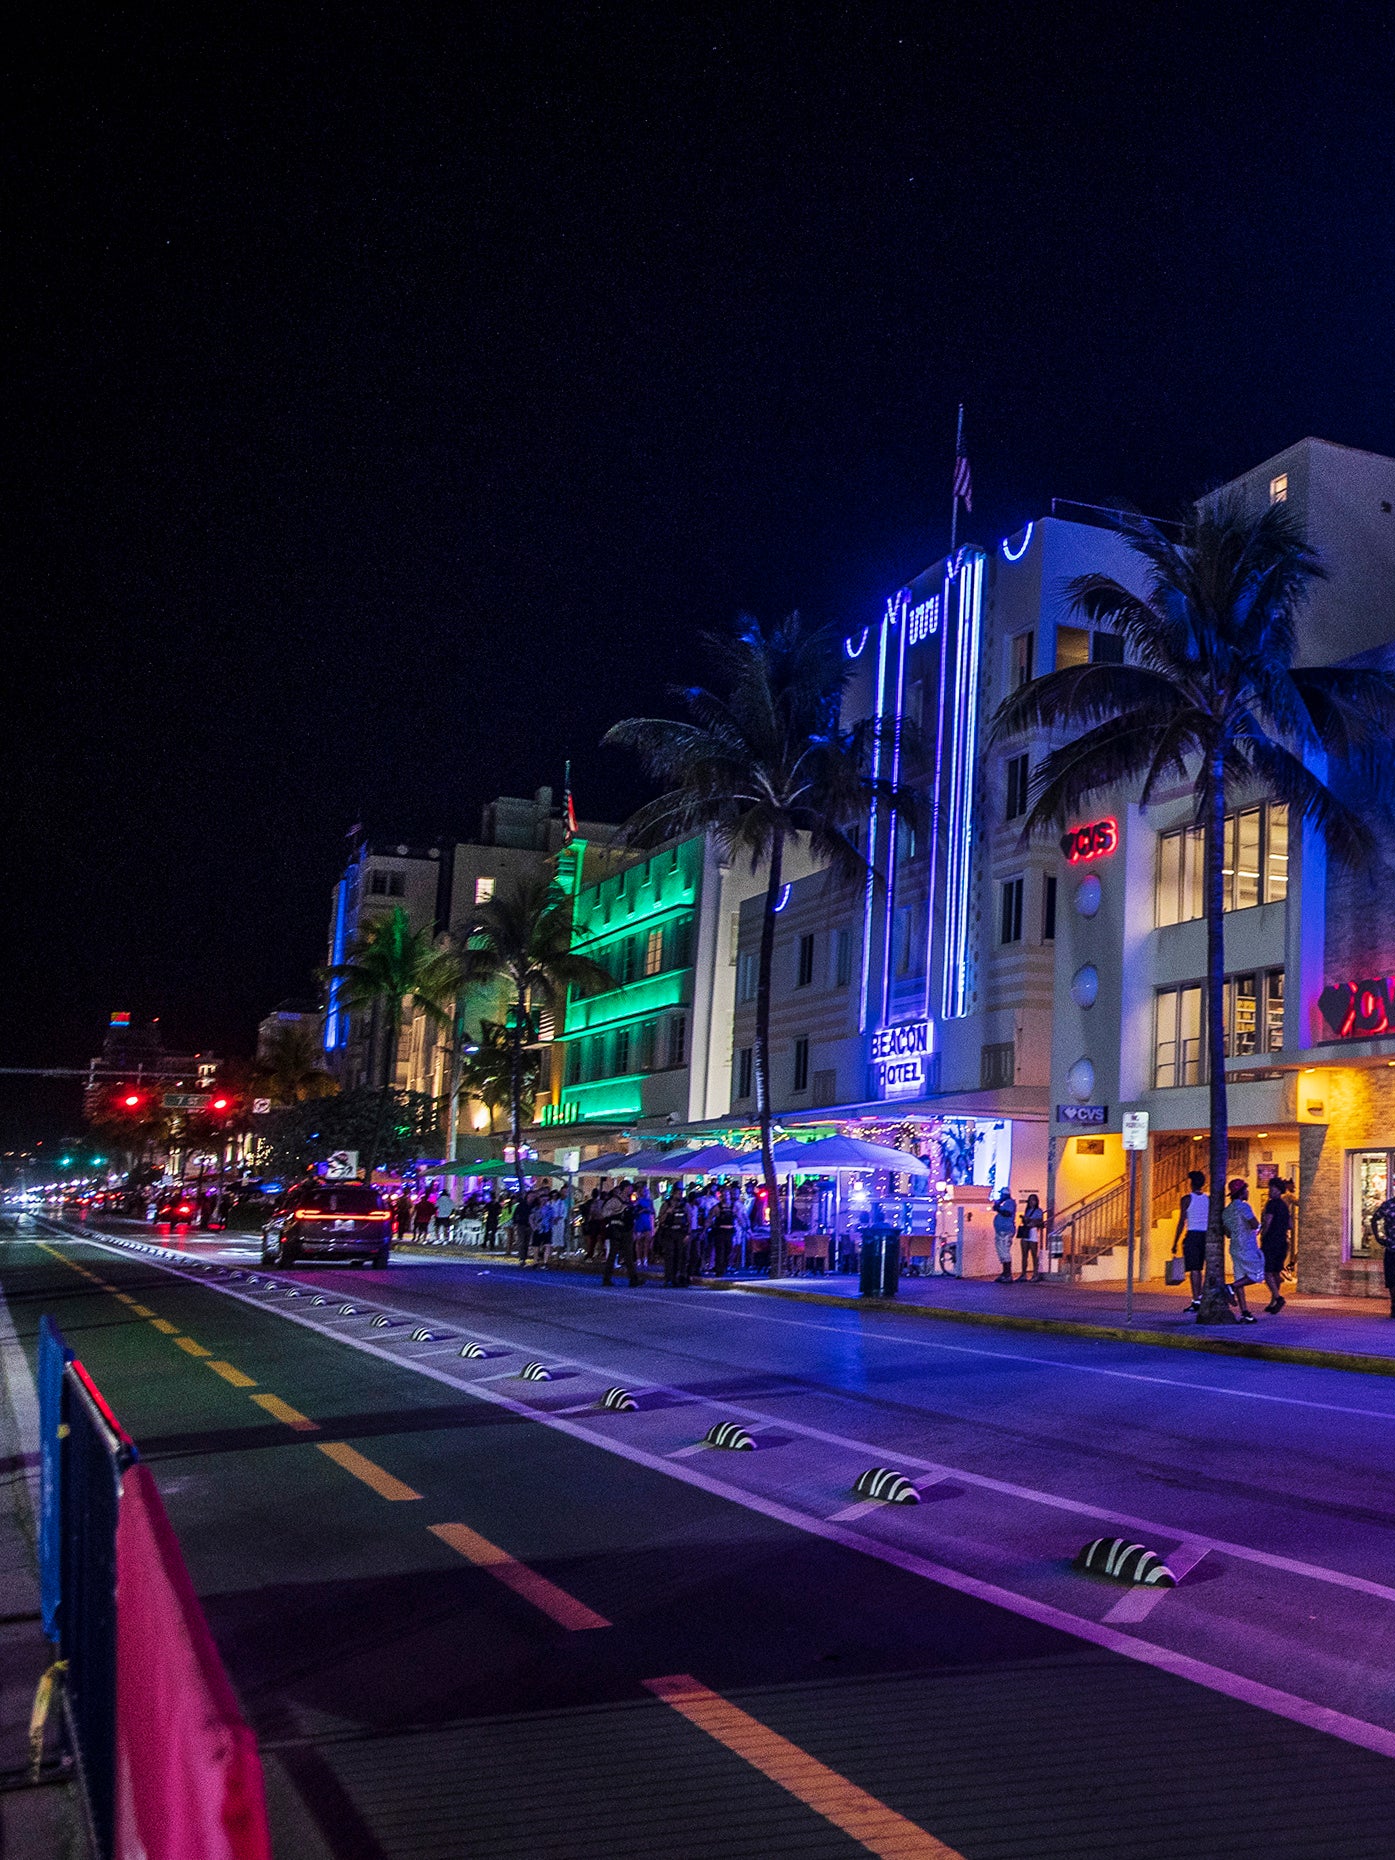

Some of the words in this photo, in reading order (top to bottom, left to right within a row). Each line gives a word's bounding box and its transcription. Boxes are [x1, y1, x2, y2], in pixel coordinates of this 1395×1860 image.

[1076, 820, 1117, 858] CVS
[872, 1024, 928, 1059] BEACON
[879, 1062, 921, 1086] HOTEL
[1077, 1108, 1104, 1120] CVS
